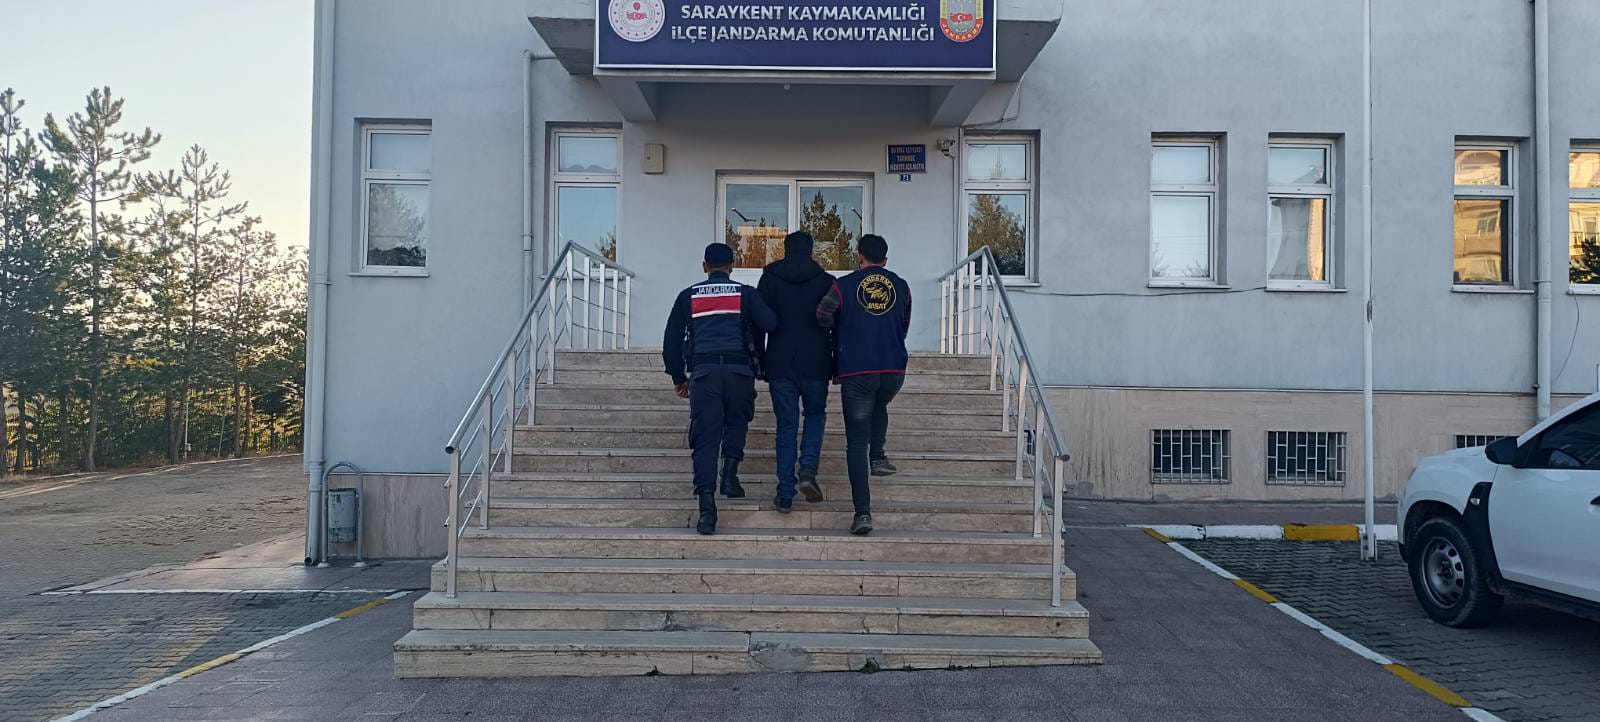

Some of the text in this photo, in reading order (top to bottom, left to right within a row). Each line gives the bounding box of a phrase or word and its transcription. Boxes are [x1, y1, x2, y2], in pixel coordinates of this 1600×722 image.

[681, 3, 925, 21] SARAYKENT KAYMAKAMLIĞI
[710, 26, 809, 42] JANDARMA
[813, 24, 935, 41] KOMUTANLIĞI
[861, 275, 893, 289] JANDARMA
[696, 286, 737, 295] JANDARMA
